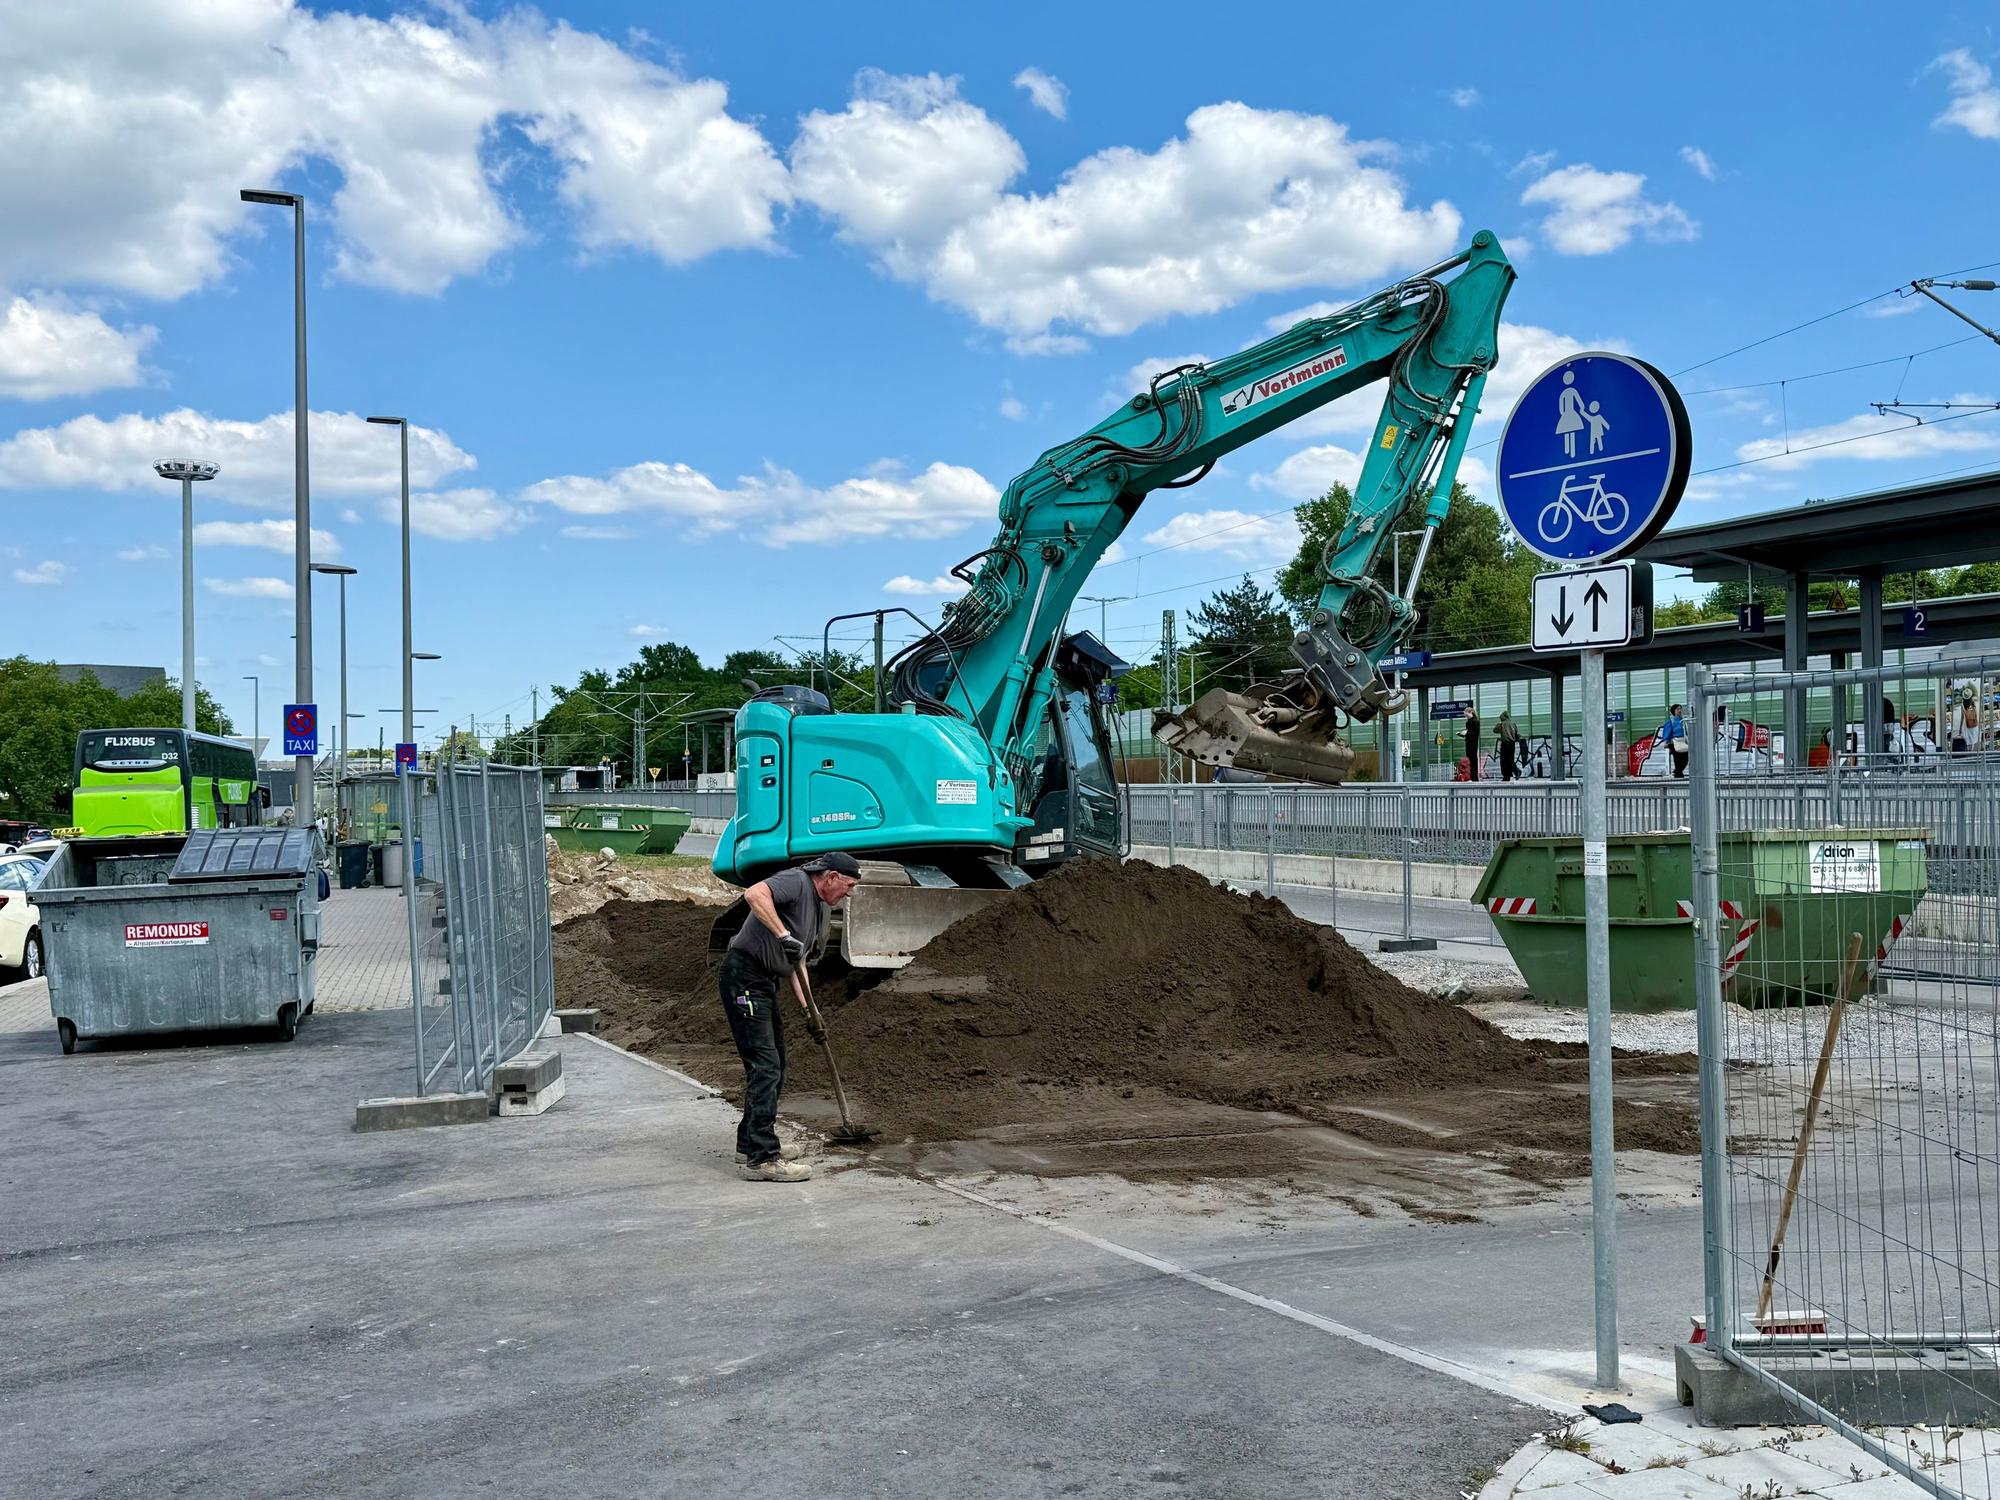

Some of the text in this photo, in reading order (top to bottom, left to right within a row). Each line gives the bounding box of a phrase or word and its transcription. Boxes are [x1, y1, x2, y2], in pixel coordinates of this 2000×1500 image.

[1257, 353, 1346, 398] Vortmann
[1745, 607, 1752, 627] 1
[1914, 612, 1925, 631] 2
[286, 739, 315, 751] TAXI
[161, 752, 179, 760] D32
[1813, 844, 1855, 862] Adrion
